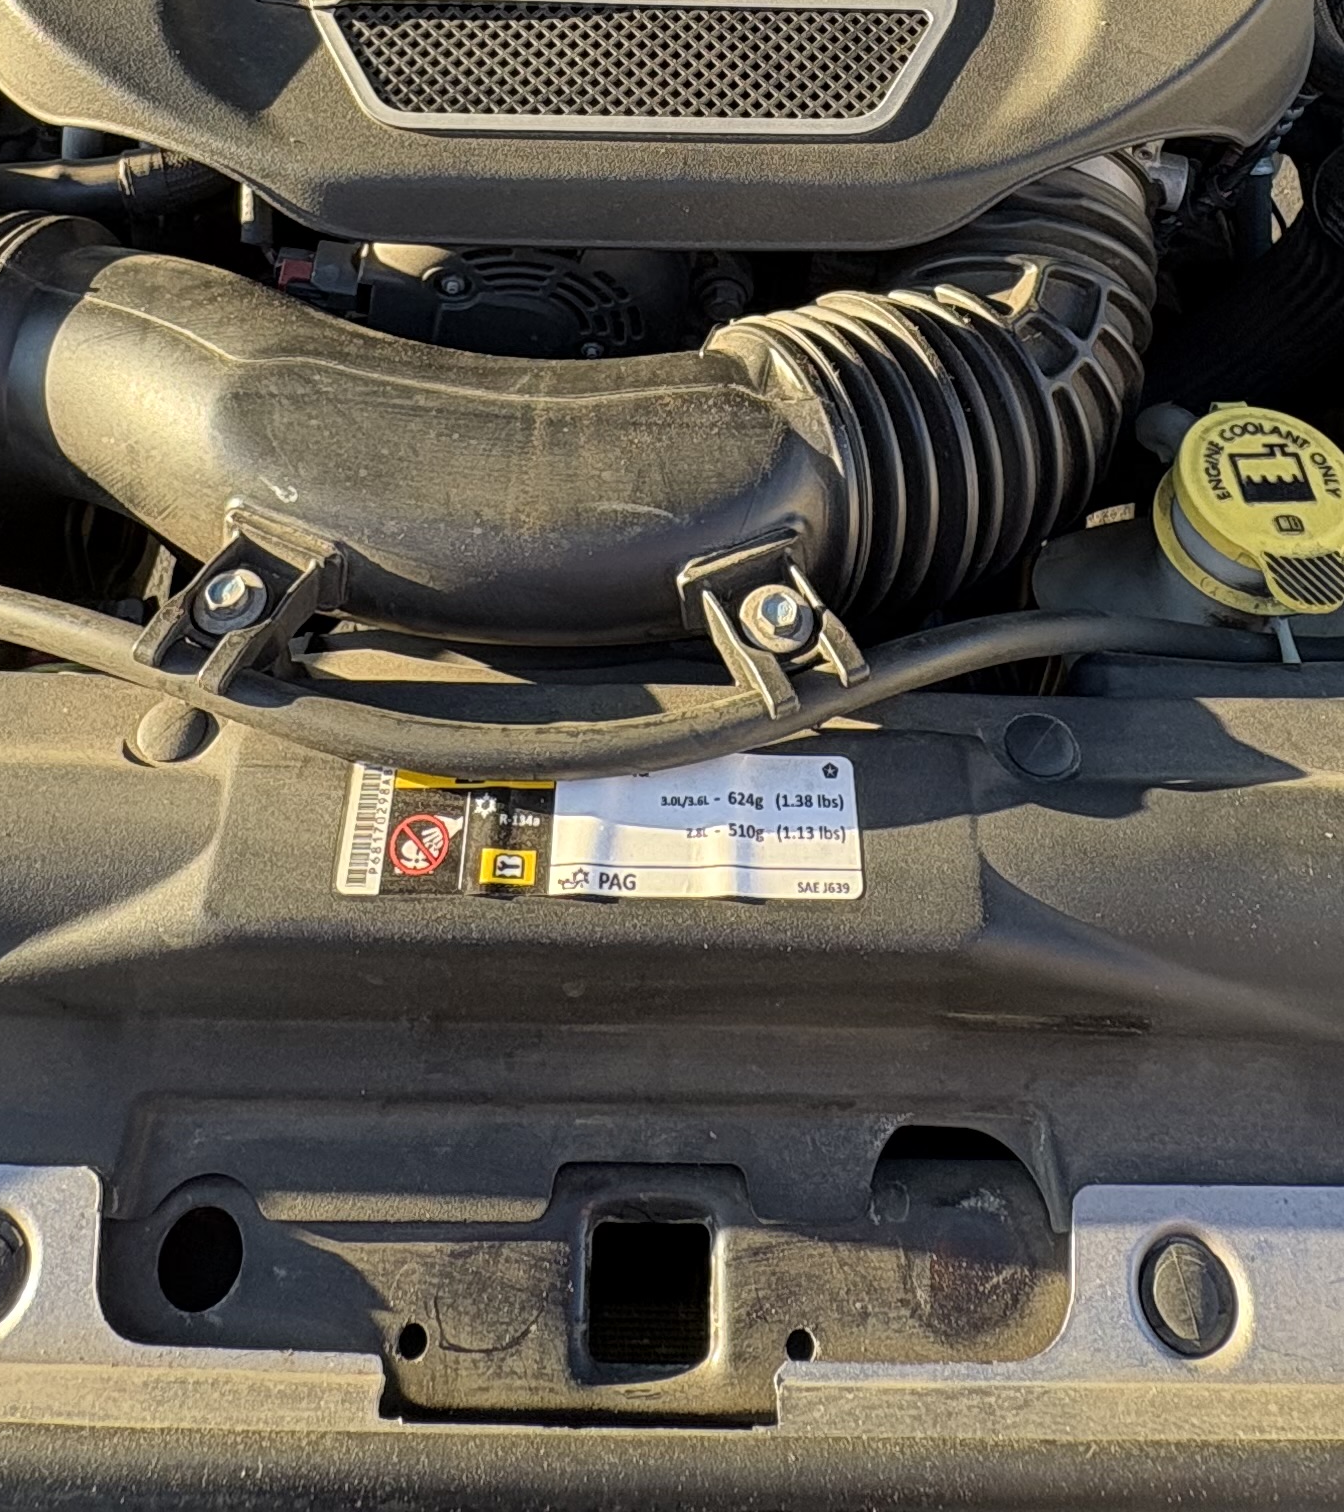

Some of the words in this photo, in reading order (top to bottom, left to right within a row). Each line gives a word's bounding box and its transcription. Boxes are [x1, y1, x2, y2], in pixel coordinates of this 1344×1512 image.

[1203, 439, 1233, 502] ENGINE
[1218, 421, 1311, 450] COOLANT
[1310, 451, 1343, 500] ONLY
[660, 795, 710, 809] 3.0L/3.6L
[727, 791, 764, 811] 624g
[775, 793, 814, 811] (1.38
[817, 793, 845, 811] lbs)
[499, 814, 541, 828] R-134a
[686, 826, 709, 839] 2.8L
[727, 823, 765, 842] 510g
[776, 824, 815, 843] (1.13
[818, 824, 847, 844] lbs)
[598, 872, 638, 891] PAG
[797, 881, 820, 894] SAE
[822, 881, 851, 895] J639
